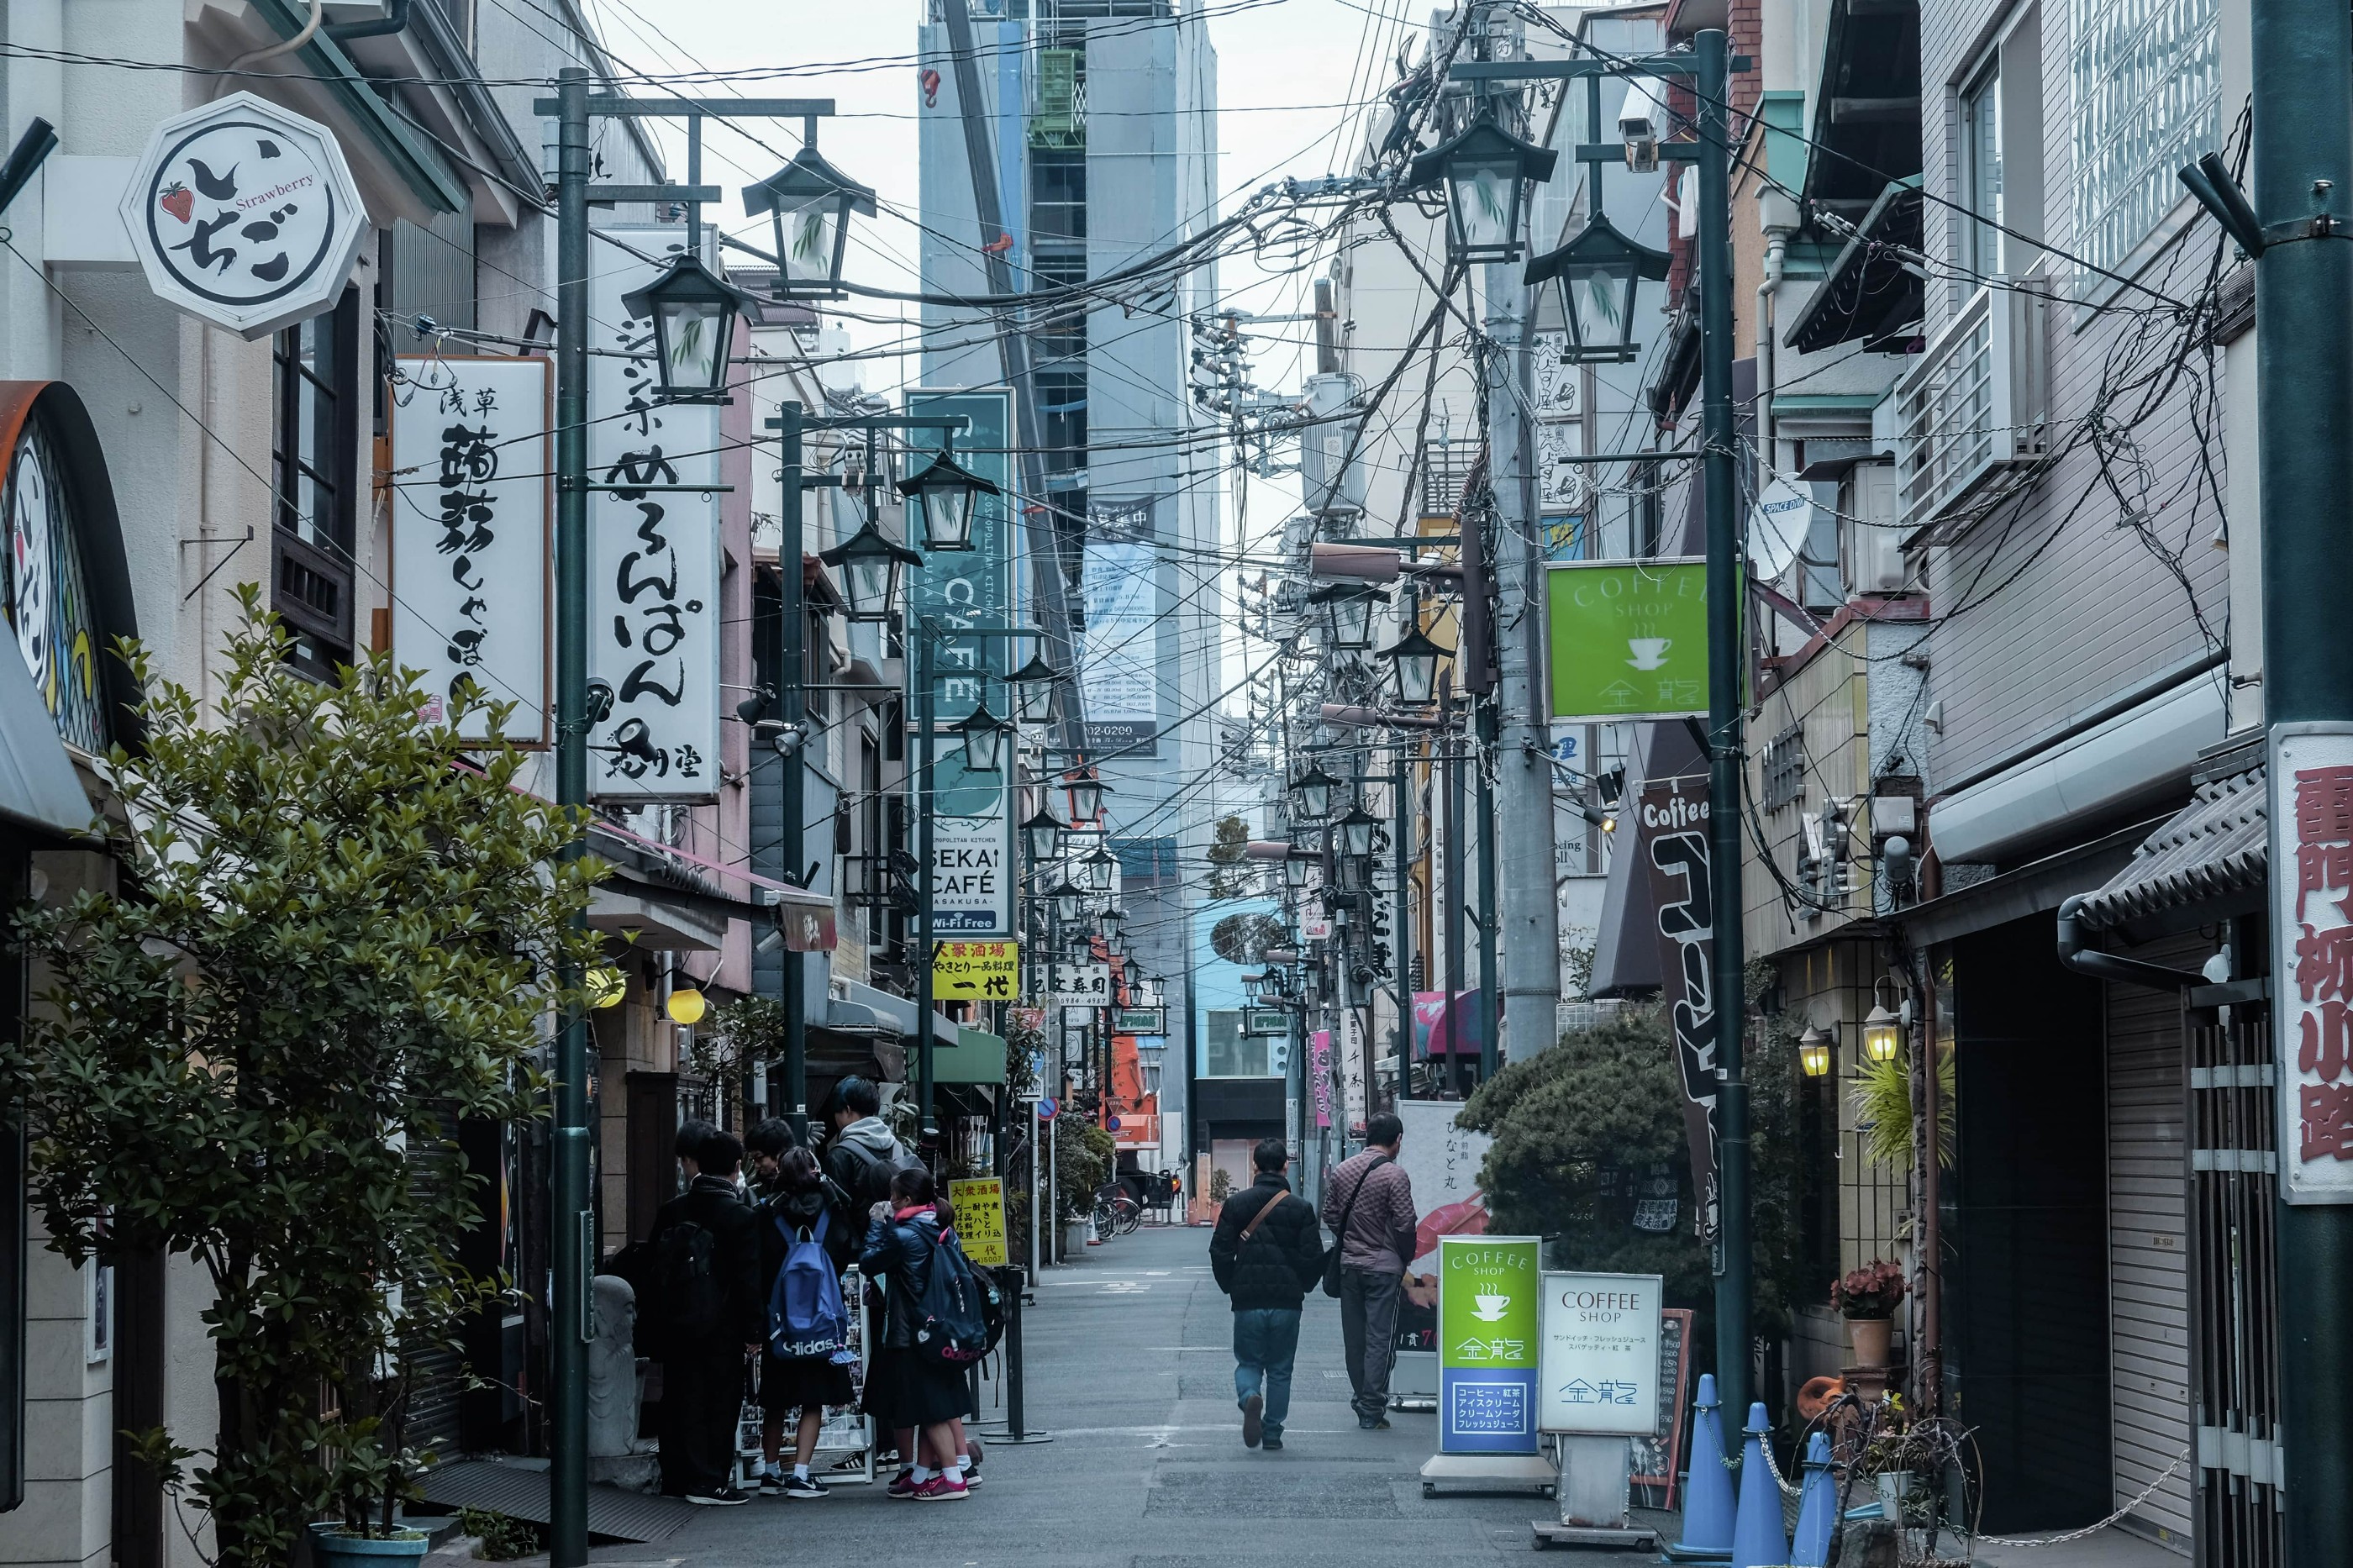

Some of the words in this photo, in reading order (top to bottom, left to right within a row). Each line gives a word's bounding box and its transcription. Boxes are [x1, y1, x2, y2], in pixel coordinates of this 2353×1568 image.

[235, 174, 313, 212] Strawberry
[440, 387, 499, 419] 浅草
[1766, 502, 1788, 514] SPACE
[1615, 602, 1674, 618] SHOP
[1597, 677, 1700, 708] 金龍
[1644, 797, 1709, 829] Coffee
[933, 870, 995, 894] CAFÉ
[933, 917, 961, 928] Wi-Fi
[965, 918, 992, 928] Free
[934, 960, 1015, 973] やきとり一品料理
[2295, 765, 2353, 1164] 雷門柳小路
[952, 975, 1009, 997] 一代
[952, 1184, 1000, 1197] 大衆酒場
[964, 1205, 974, 1239] 一品料理
[982, 1202, 991, 1238] やきとり
[1452, 1250, 1528, 1271] COFFEE
[1474, 1267, 1505, 1276] SHOP
[1562, 1292, 1640, 1310] COFFEE
[1580, 1312, 1622, 1323] SHOP
[1455, 1337, 1524, 1360] 金龍
[1459, 1388, 1520, 1397] コーヒー・紅茶
[1559, 1378, 1638, 1405] 金龍
[1459, 1398, 1520, 1408] アイスクリーム
[1459, 1409, 1520, 1418] クリームソーダ
[1459, 1419, 1520, 1429] フレッシュジュース
